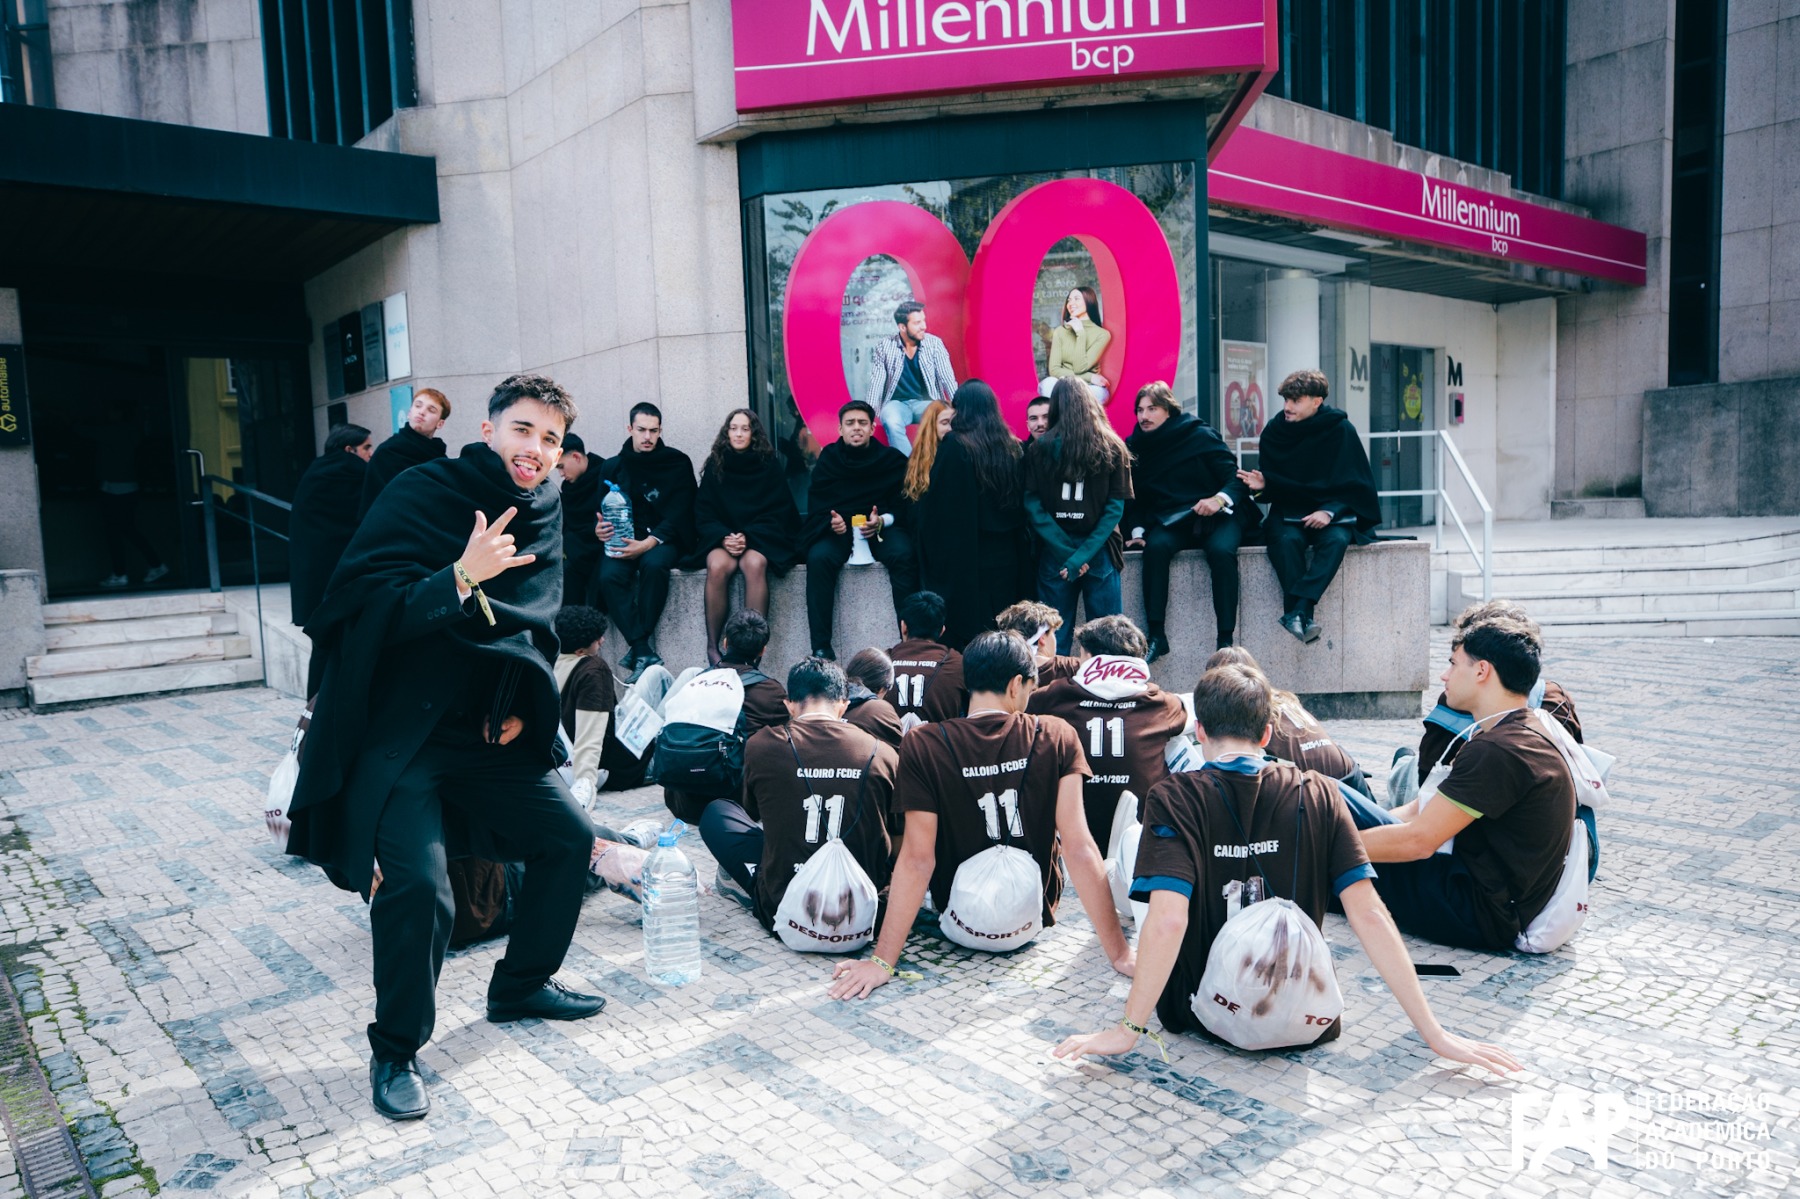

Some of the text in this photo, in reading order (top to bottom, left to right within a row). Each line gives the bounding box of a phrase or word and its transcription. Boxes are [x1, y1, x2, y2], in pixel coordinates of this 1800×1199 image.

[1071, 41, 1135, 74] bcp
[1420, 173, 1521, 237] Millennium
[1491, 234, 1509, 257] bcp
[1349, 346, 1369, 382] M
[1446, 355, 1463, 387] M
[895, 673, 925, 708] 11
[1086, 716, 1125, 758] 11
[796, 768, 862, 779] CALOIRO FCDEF
[1000, 758, 1028, 773] FCDEF
[803, 794, 845, 844] 11
[977, 788, 1025, 840] 11
[788, 919, 873, 943] DESPORTO
